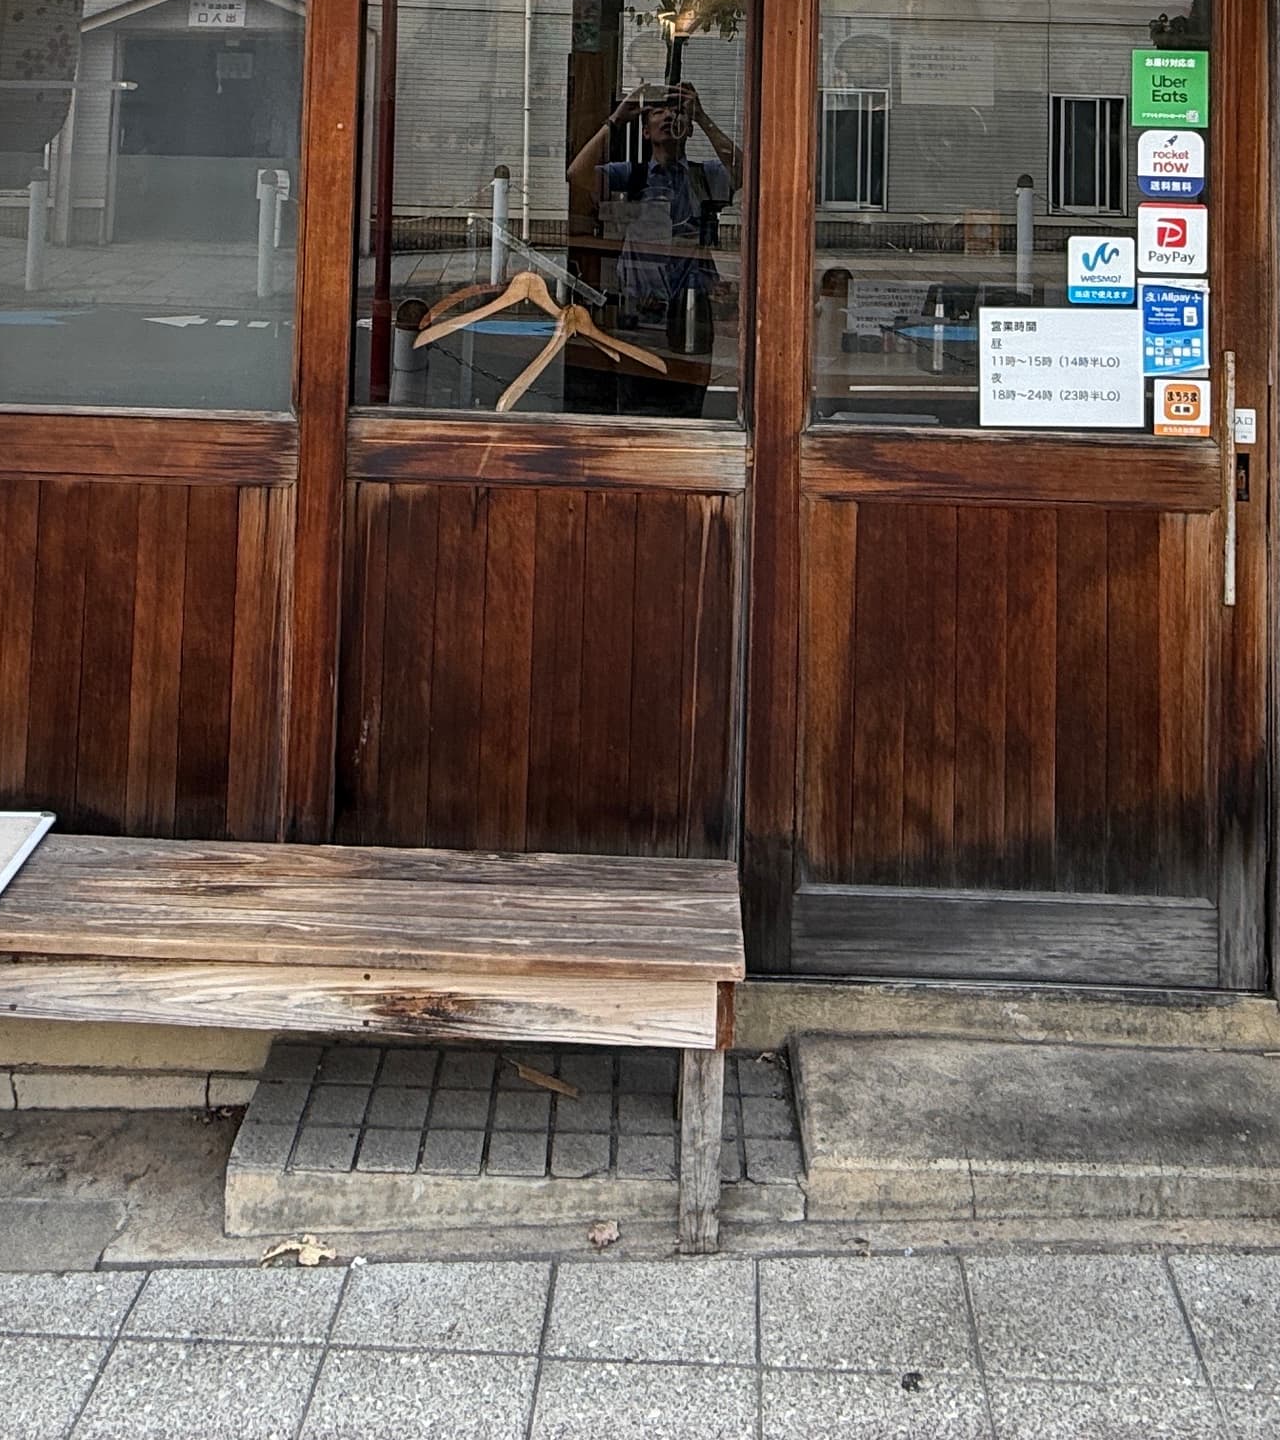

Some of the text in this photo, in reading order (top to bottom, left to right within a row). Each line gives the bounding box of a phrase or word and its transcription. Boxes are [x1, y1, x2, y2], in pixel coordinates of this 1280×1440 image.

[1151, 75, 1188, 89] Uber
[1151, 89, 1189, 103] Eats
[1152, 150, 1189, 160] rocket
[1152, 161, 1190, 173] now
[1150, 181, 1193, 192] 送料無料
[1148, 250, 1196, 265] PayPay
[990, 320, 1037, 332] 営業時間
[990, 338, 1003, 350] 昼
[991, 372, 1003, 384] 夜
